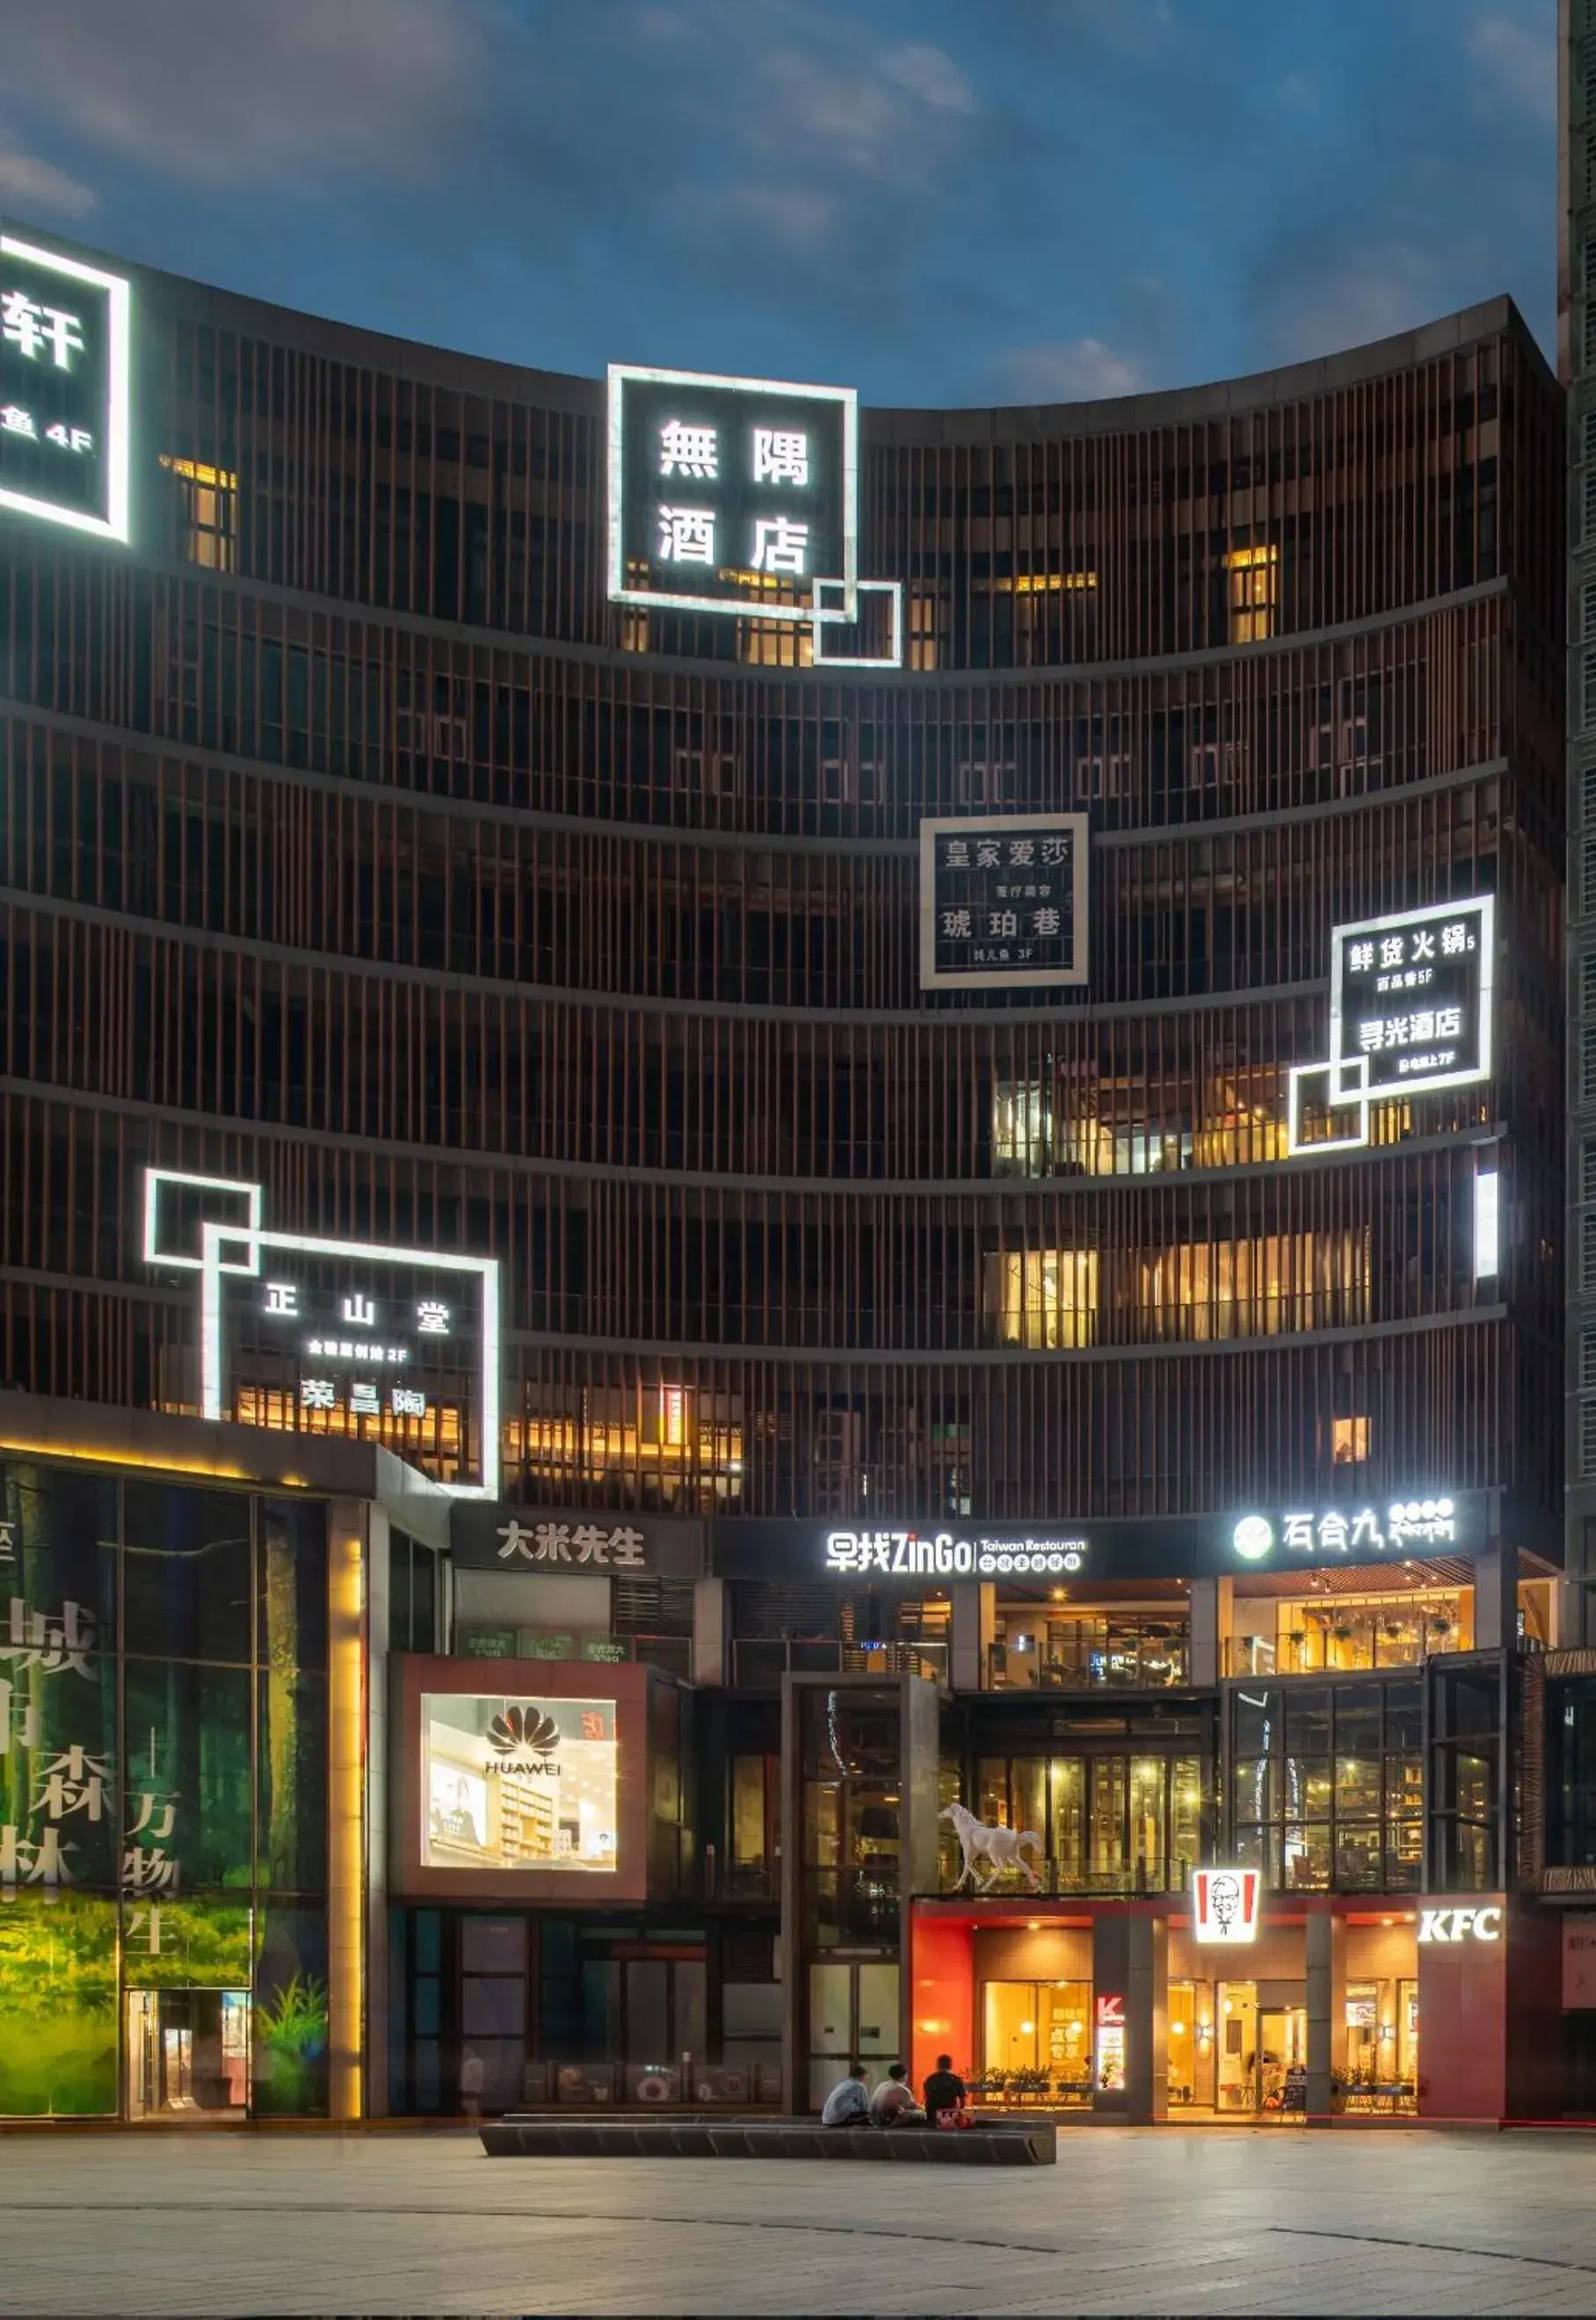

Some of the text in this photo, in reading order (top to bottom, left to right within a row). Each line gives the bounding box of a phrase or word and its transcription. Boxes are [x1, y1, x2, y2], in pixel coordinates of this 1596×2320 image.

[46, 424, 93, 453] 4F
[660, 419, 808, 485] 無隅
[659, 505, 808, 575] 酒店
[946, 837, 1069, 868] 皇家爱莎
[942, 907, 1061, 939] 琥珀巷
[1349, 923, 1467, 973] 鲜货火锅
[1360, 1008, 1461, 1052] 寻光酒店
[265, 1282, 451, 1334] 正山堂
[301, 1379, 427, 1417] 荣昌陶
[496, 1519, 647, 1566] 大米先生
[979, 1538, 1025, 1552] Taiwan
[485, 1760, 562, 1777] HUAWEI
[1418, 1907, 1502, 1943] KFC
